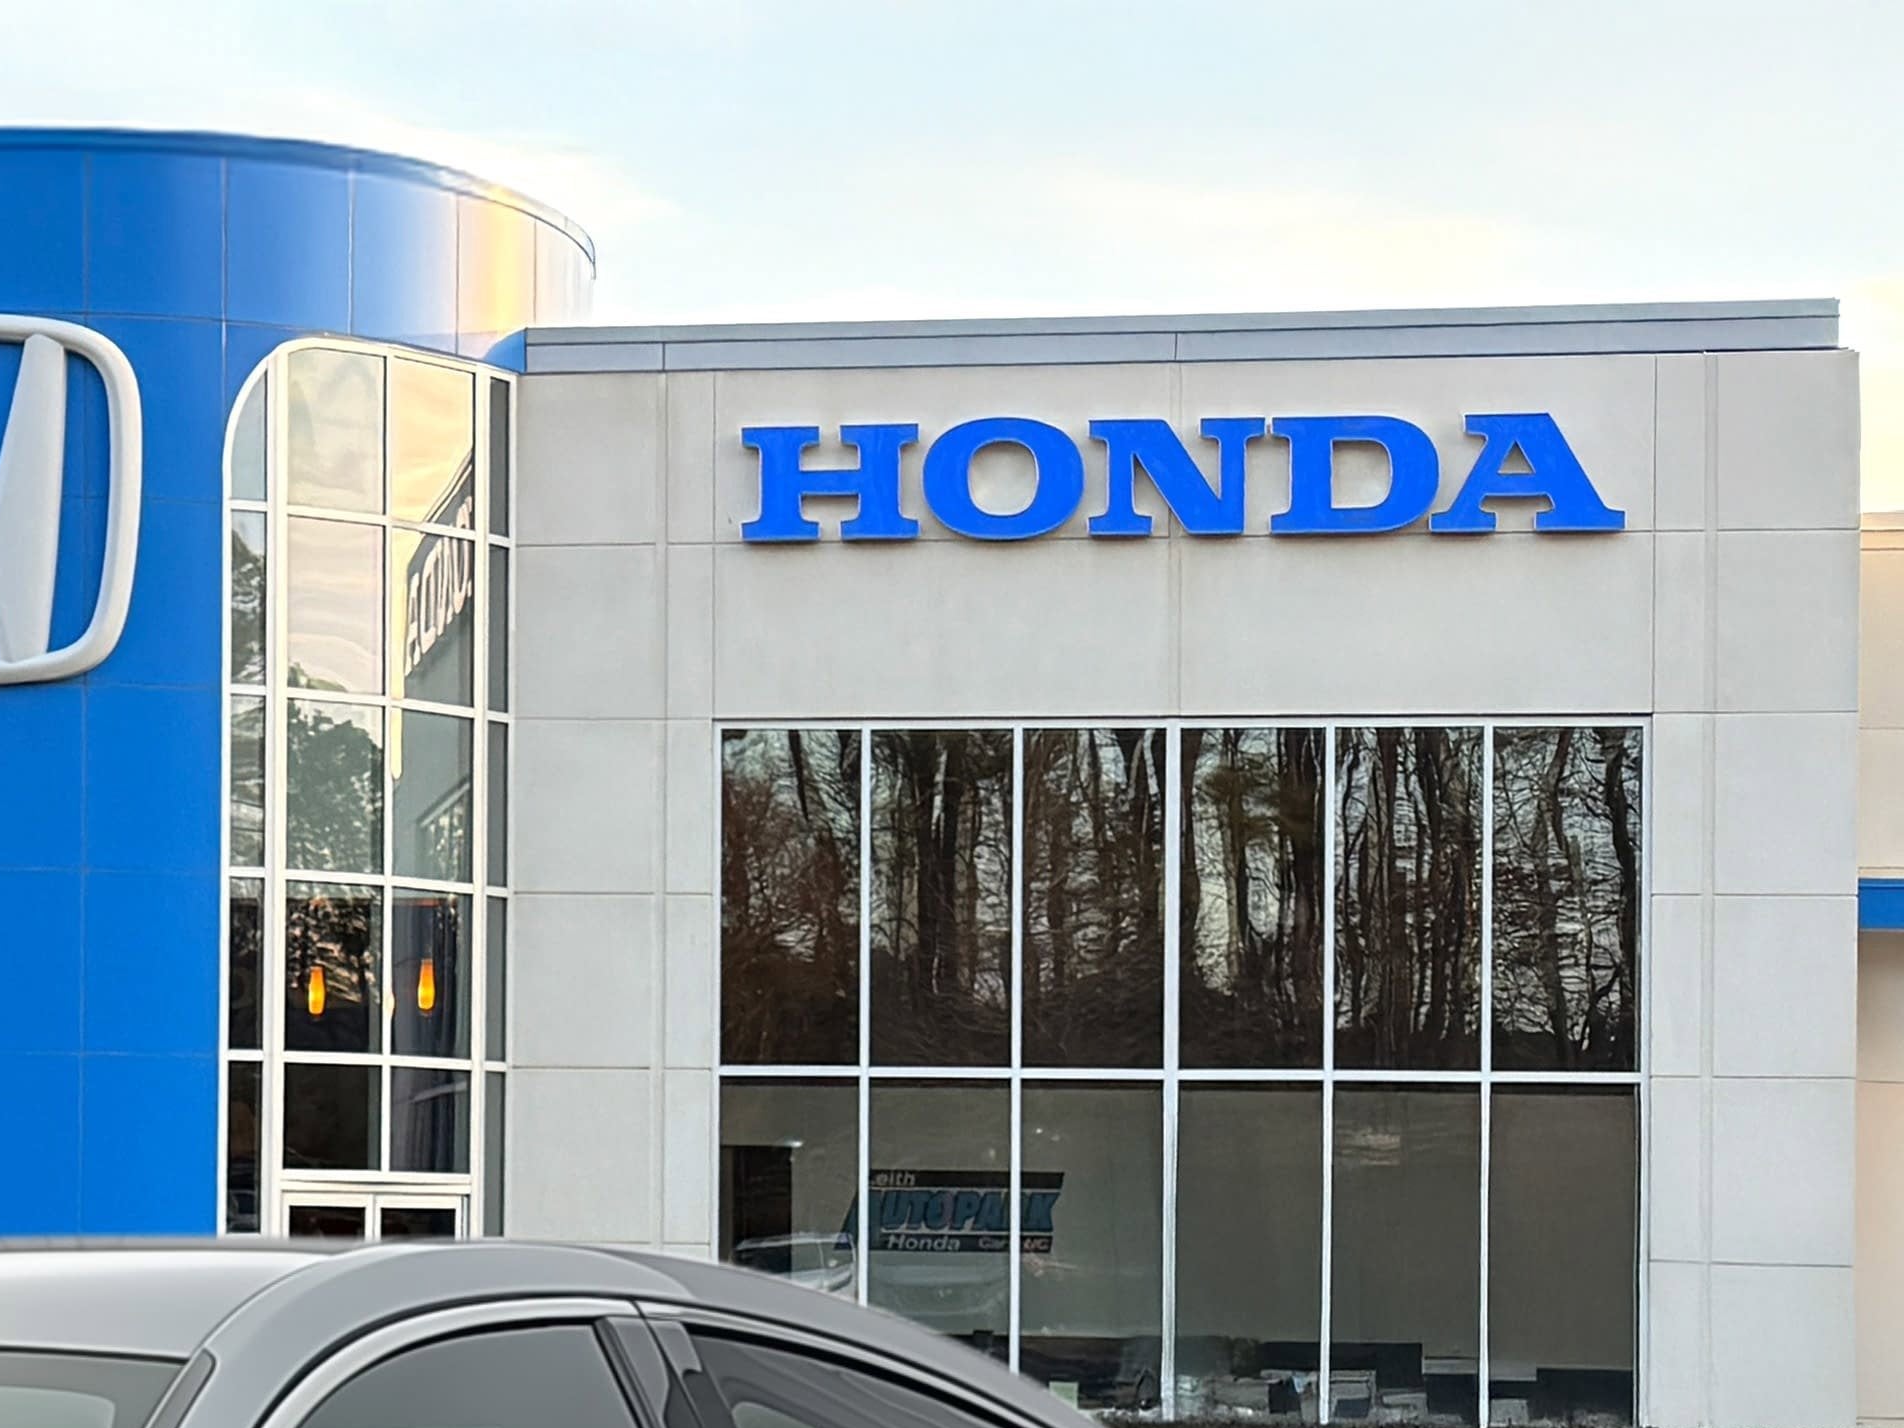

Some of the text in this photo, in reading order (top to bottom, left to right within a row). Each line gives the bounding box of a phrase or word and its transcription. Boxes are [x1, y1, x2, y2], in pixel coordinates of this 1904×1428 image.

[741, 412, 1626, 540] HONDA
[871, 1171, 916, 1186] eith
[888, 1234, 961, 1251] Honda
